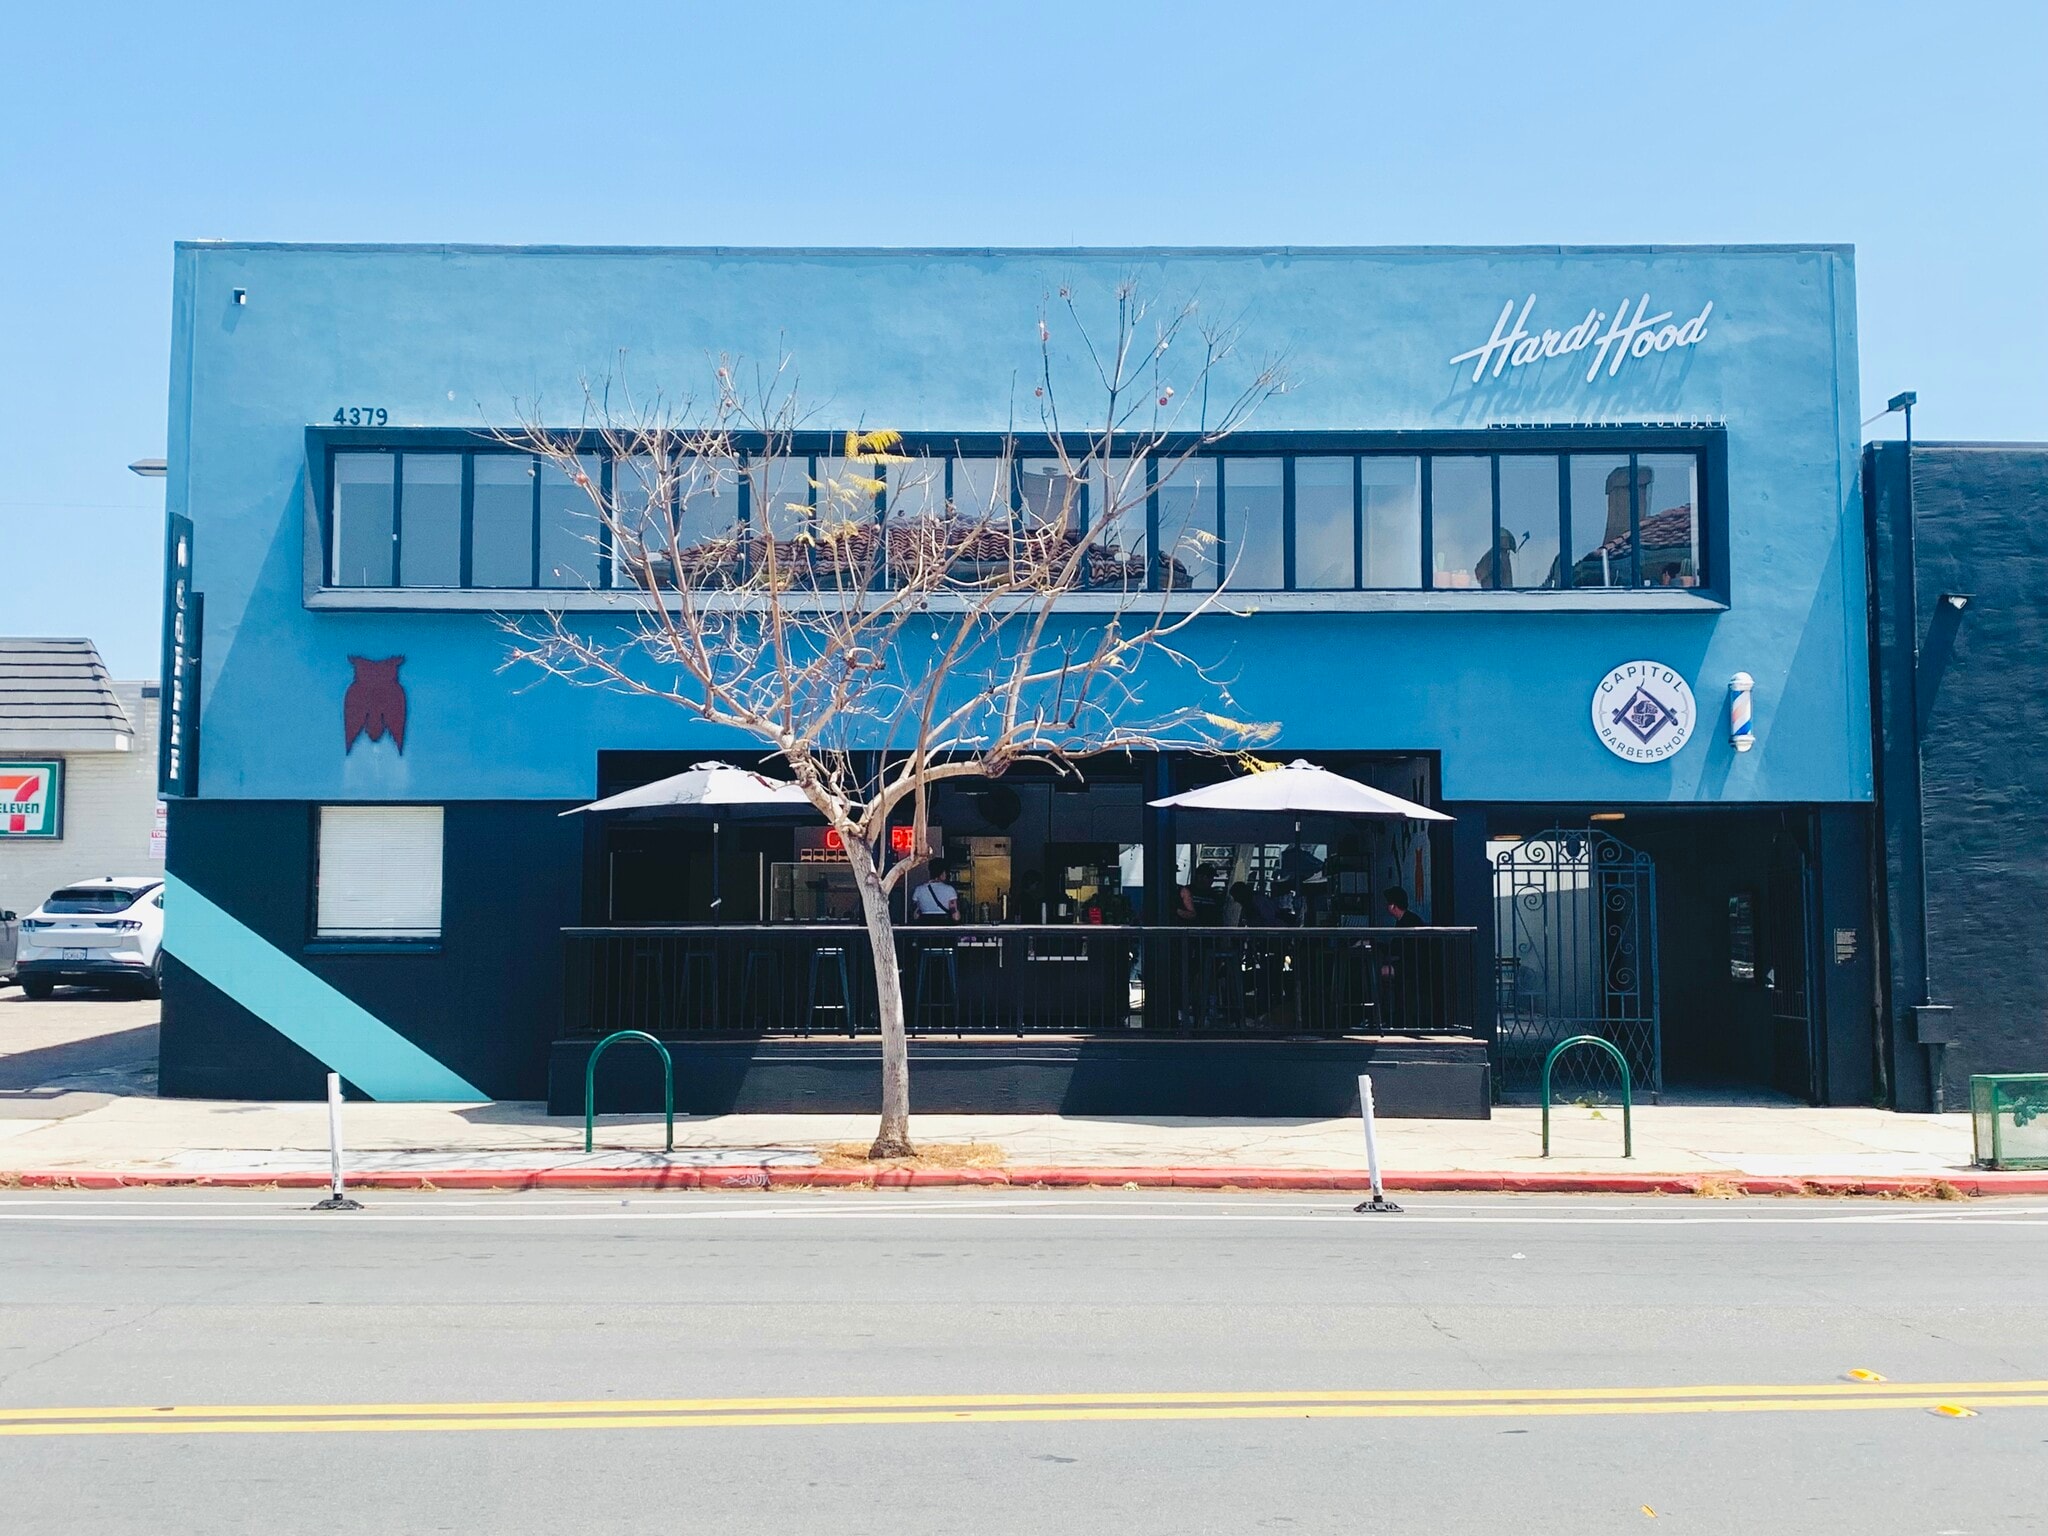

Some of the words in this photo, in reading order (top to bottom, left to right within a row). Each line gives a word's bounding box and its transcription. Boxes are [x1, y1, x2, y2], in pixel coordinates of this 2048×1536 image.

[333, 407, 388, 426] 4379
[1485, 416, 1552, 428] NORTH
[1570, 415, 1623, 428] PARK
[1601, 665, 1682, 693] CAPITOL
[1602, 728, 1686, 759] BARBERSHOP
